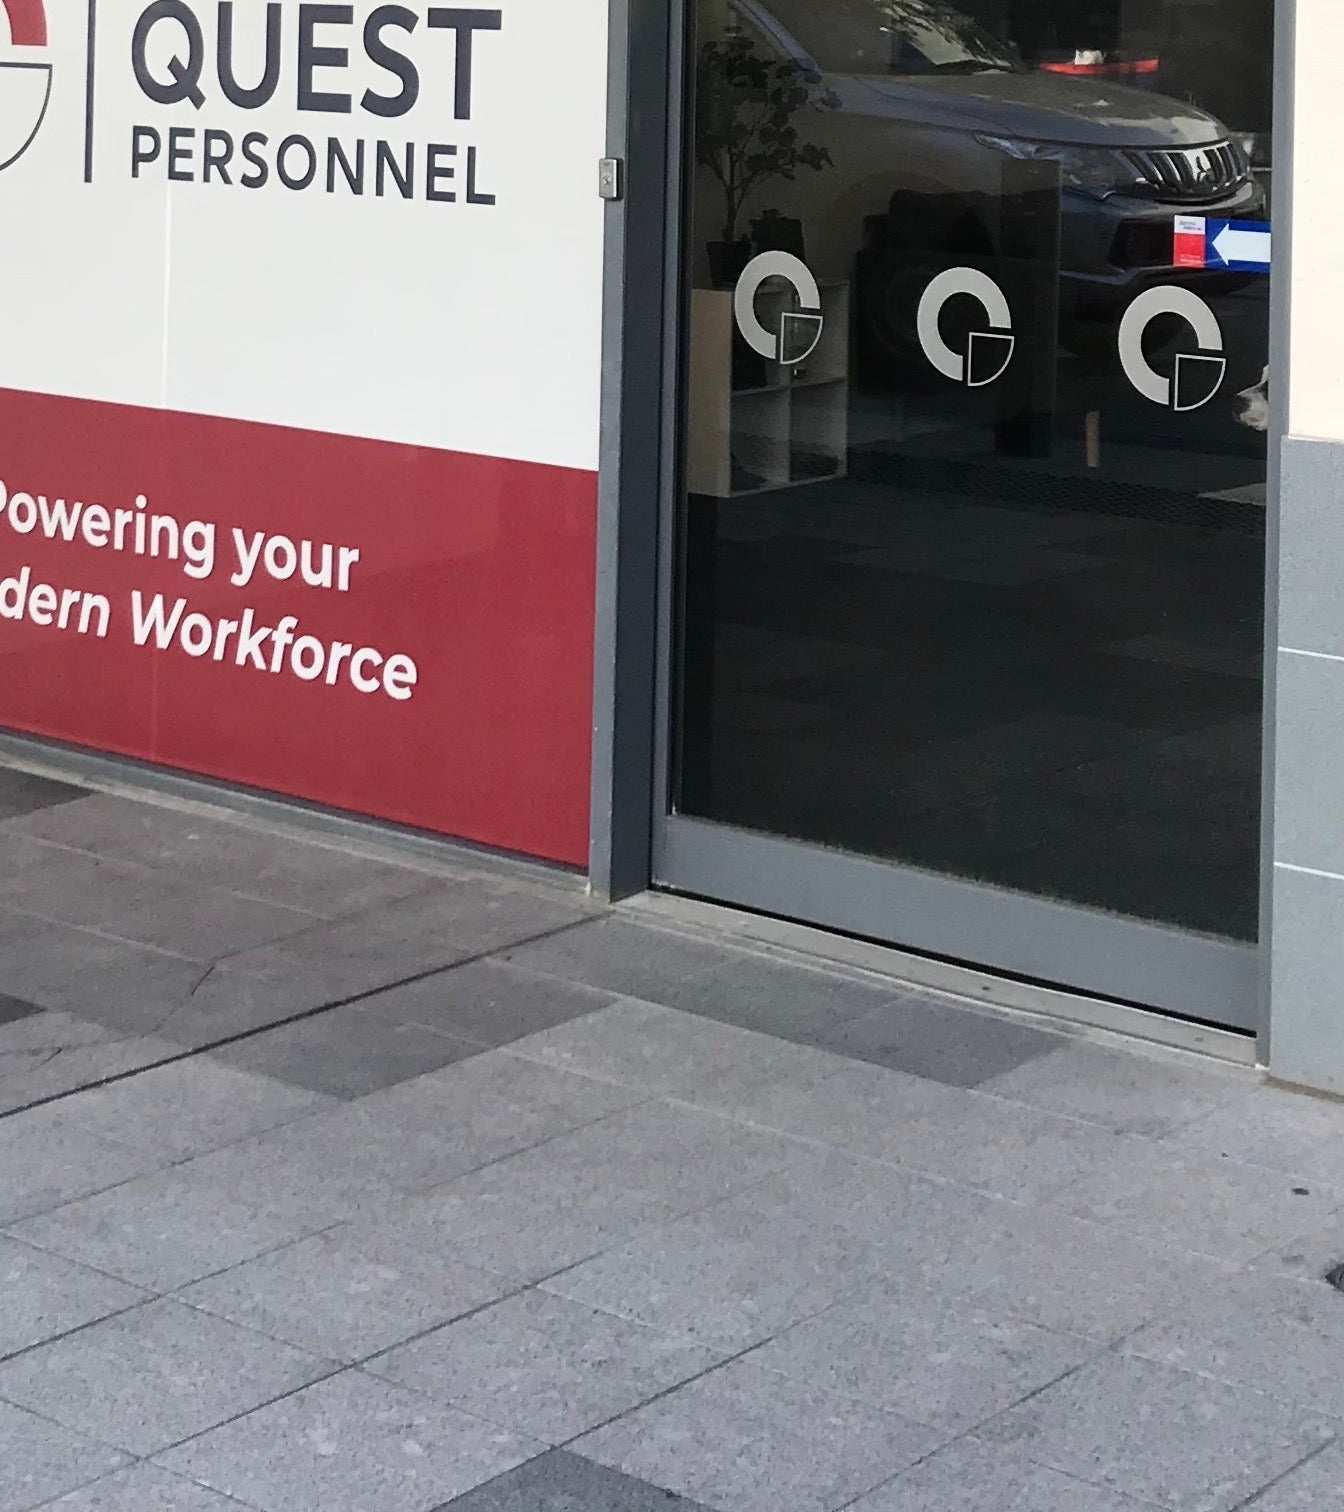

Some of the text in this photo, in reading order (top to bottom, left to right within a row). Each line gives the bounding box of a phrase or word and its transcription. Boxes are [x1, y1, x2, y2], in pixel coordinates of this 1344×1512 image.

[131, 124, 496, 206] PERSONNEL
[230, 526, 360, 592] your
[131, 590, 418, 700] Workforce
